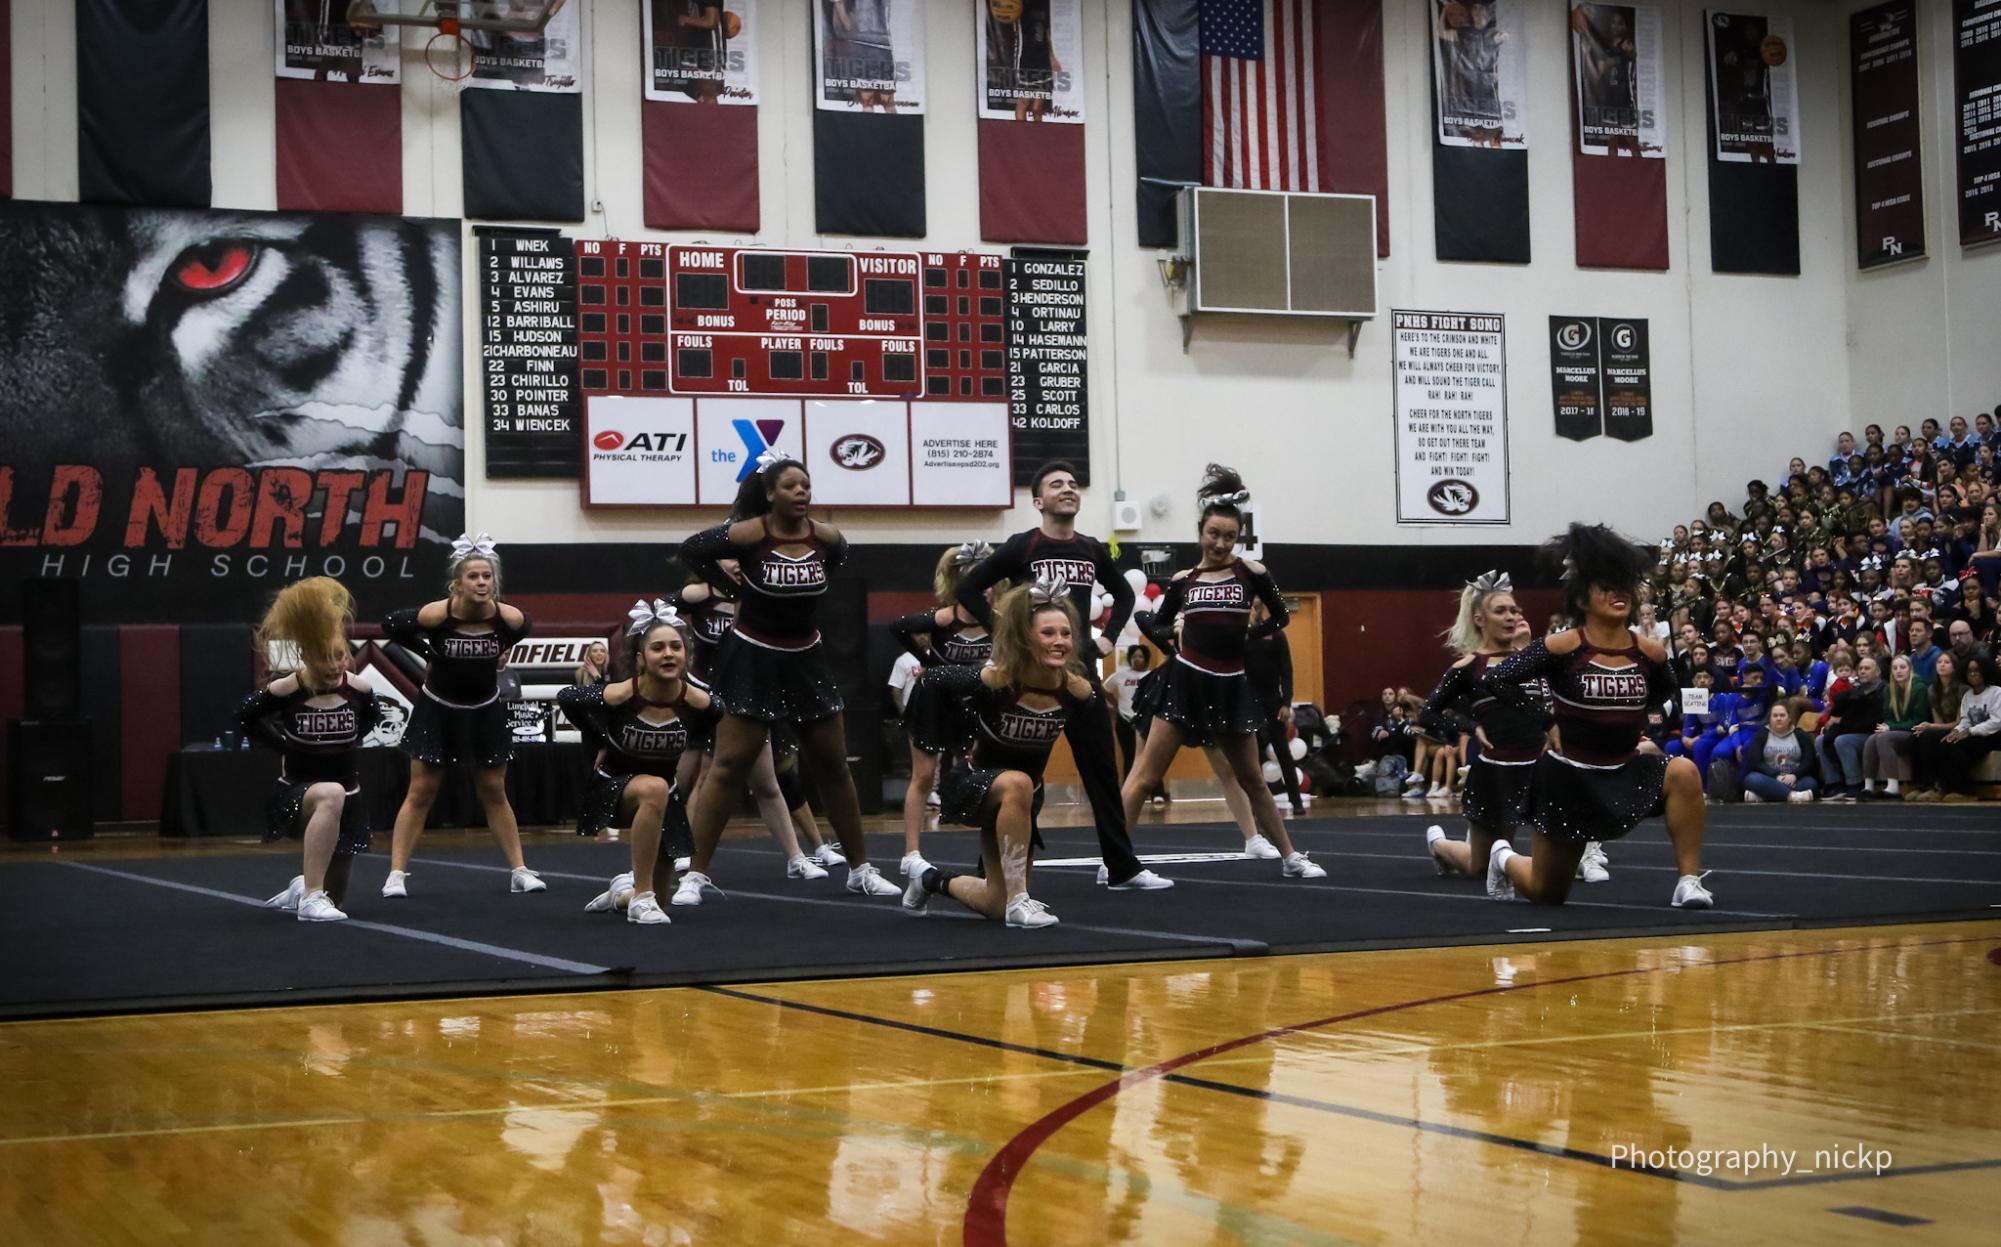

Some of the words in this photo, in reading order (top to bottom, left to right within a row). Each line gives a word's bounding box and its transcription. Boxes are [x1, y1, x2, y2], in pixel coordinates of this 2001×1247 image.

[287, 44, 313, 55] BOYS
[655, 69, 679, 78] BOYS
[825, 79, 848, 88] BOYS
[988, 88, 1011, 98] BOYS
[492, 239, 496, 251] 1
[516, 240, 549, 252] WNEK
[490, 256, 499, 268] 2
[584, 242, 600, 254] NO
[619, 243, 626, 255] F
[641, 244, 662, 256] PTS
[680, 252, 724, 268] HOME
[859, 257, 917, 275] VISITOR
[929, 254, 943, 266] NO
[960, 256, 967, 267] F
[980, 256, 999, 268] PTS
[1012, 262, 1016, 273] 1
[1024, 263, 1084, 276] GONZALEZ
[491, 271, 499, 283] 3
[508, 271, 564, 284] ALVAREZ
[491, 285, 500, 298] 4
[513, 285, 555, 298] EVANS
[1010, 279, 1017, 290] 2
[1032, 279, 1079, 291] SEDILLO
[775, 298, 796, 308] POSS
[1011, 292, 1019, 303] 3
[1020, 292, 1084, 305] HENDERSON
[491, 300, 501, 312] 5
[513, 301, 560, 313] ASHIRU
[1011, 306, 1019, 317] 4
[1032, 307, 1081, 319] ORTINAU
[487, 315, 501, 327] 12
[506, 315, 576, 328] BARRIBALL
[698, 315, 735, 328] BONUS
[766, 309, 806, 321] PERIOD
[859, 319, 895, 332] BONUS
[1011, 320, 1024, 331] 10
[1040, 320, 1076, 332] LARRY
[1395, 314, 1428, 328] PNHS
[1431, 316, 1466, 330] FIGHT
[1470, 318, 1500, 331] SONG
[489, 330, 502, 342] 15
[513, 330, 562, 342] HUDSON
[1013, 334, 1024, 345] 14
[1028, 334, 1087, 346] HASEMANN
[1430, 333, 1440, 343] THE
[1442, 334, 1466, 344] CRIMSON
[1468, 335, 1478, 344] AND
[1480, 336, 1497, 345] WHITE
[1563, 324, 1580, 346] G
[1617, 329, 1632, 348] G
[677, 335, 712, 348] FOULS
[761, 337, 802, 349] PLAYER
[810, 339, 844, 351] FOULS
[882, 340, 915, 352] FOULS
[483, 345, 492, 356] 21
[1009, 347, 1020, 359] 15
[1022, 348, 1086, 360] PATTERSON
[1409, 346, 1417, 356] WE
[1419, 347, 1429, 357] ARE
[1431, 348, 1451, 358] TIGERS
[1453, 348, 1463, 358] ONE
[1465, 349, 1476, 359] AND
[488, 360, 504, 372] 22
[526, 360, 554, 372] FINN
[1010, 361, 1021, 373] 21
[1038, 362, 1080, 374] GARCIA
[1399, 360, 1406, 370] WE
[1408, 361, 1421, 371] WILL
[1423, 362, 1443, 371] ALWAYS
[1446, 362, 1463, 372] CHEER
[1464, 363, 1475, 372] FOR
[490, 374, 506, 386] 23
[511, 374, 569, 387] CHIRILLO
[728, 380, 749, 391] TOL
[847, 382, 869, 394] TOL
[1011, 375, 1025, 387] 23
[1039, 376, 1081, 388] GRUBER
[1405, 375, 1416, 384] AND
[1418, 376, 1431, 385] WILL
[1432, 376, 1451, 386] SOUND
[1452, 377, 1463, 386] THE
[1464, 377, 1480, 387] TIGER
[1482, 378, 1495, 387] CALL
[490, 389, 507, 401] 30
[515, 389, 568, 402] POINTER
[1011, 389, 1026, 400] 25
[1041, 390, 1077, 401] SCOTT
[492, 404, 509, 416] 33
[517, 404, 560, 417] BANAS
[1012, 403, 1027, 414] 33
[1410, 409, 1427, 419] CHEER
[1429, 409, 1439, 419] FOR
[1441, 410, 1451, 419] THE
[1453, 410, 1472, 420] NORTH
[1473, 411, 1492, 420] TIGERS
[1560, 406, 1579, 415] 2017
[493, 419, 510, 431] 34
[515, 419, 570, 431] WIENCEK
[1012, 417, 1027, 428] 42
[1030, 417, 1081, 429] KOLDOFF
[1408, 423, 1416, 432] WE
[1418, 423, 1429, 433] ARE
[1431, 424, 1444, 433] WITH
[1447, 424, 1457, 434] YOU
[1459, 424, 1469, 434] ALL
[1470, 425, 1480, 434] THE
[625, 433, 687, 451] ATI
[922, 439, 971, 448] ADVERTISE
[975, 440, 998, 448] HERE
[1427, 438, 1438, 447] GET
[1439, 438, 1450, 448] OUT
[1452, 438, 1469, 448] THERE
[1471, 439, 1486, 448] TEAM
[593, 453, 637, 462] PHYSICAL
[641, 454, 682, 462] THERAPY
[712, 449, 736, 463] the
[731, 419, 785, 483] Y
[927, 449, 950, 458] (815)
[1415, 451, 1426, 461] AND
[1431, 466, 1442, 476] AND
[1444, 466, 1454, 476] WIN
[123, 467, 430, 549] NORTH
[40, 554, 173, 577] HIGH
[210, 554, 415, 578] SCHOOL
[762, 562, 827, 587] TIGERS
[1031, 560, 1095, 586] TIGERS
[1188, 584, 1243, 604] TIGERS
[445, 639, 500, 658] TIGERS
[946, 642, 992, 664] TIGERS
[1581, 674, 1647, 699] TIGERS
[295, 711, 355, 735] TIGERS
[622, 726, 687, 753] TIGERS
